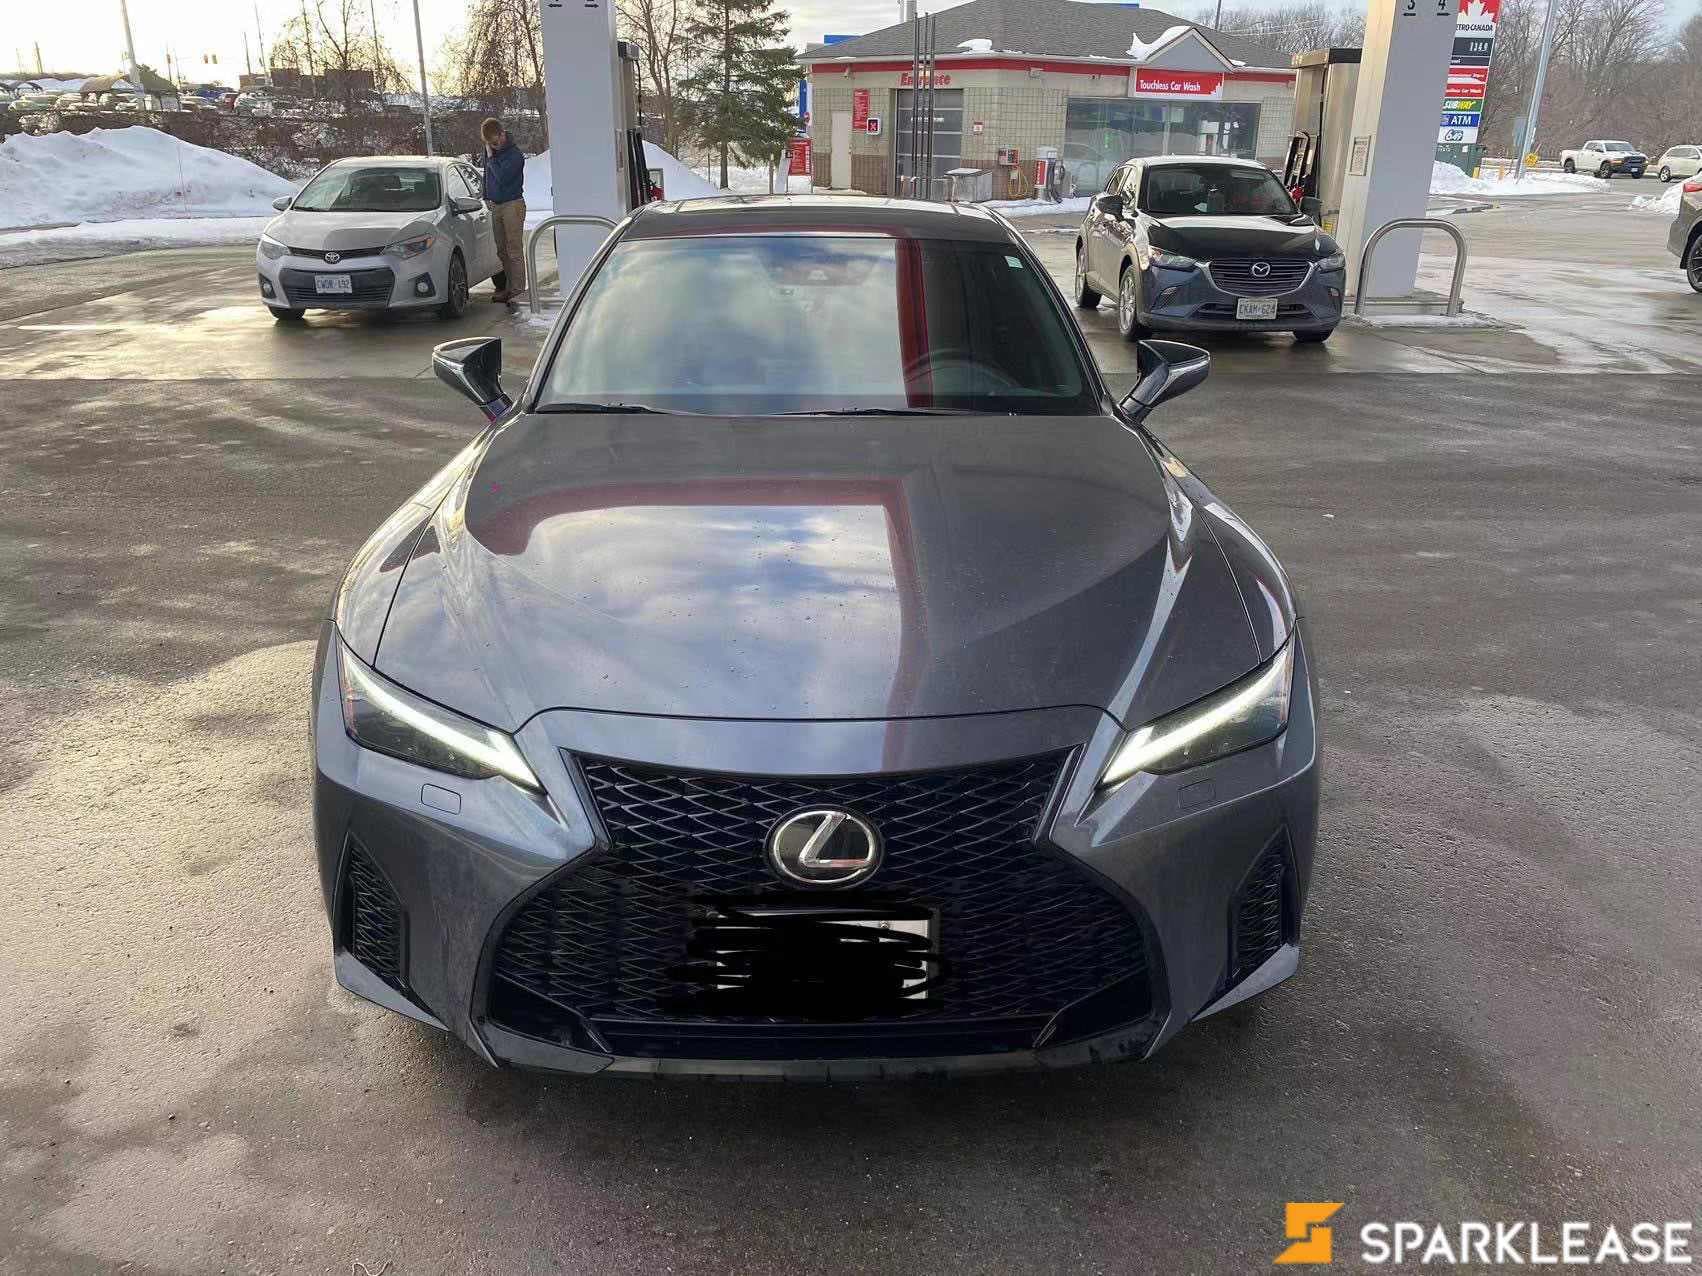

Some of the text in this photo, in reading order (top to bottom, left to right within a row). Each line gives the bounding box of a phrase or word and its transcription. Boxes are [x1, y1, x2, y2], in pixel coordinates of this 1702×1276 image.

[1456, 23, 1494, 32] ETRO-CANADA
[1139, 79, 1201, 92] Touchless Car Wash
[1450, 115, 1472, 125] ATM
